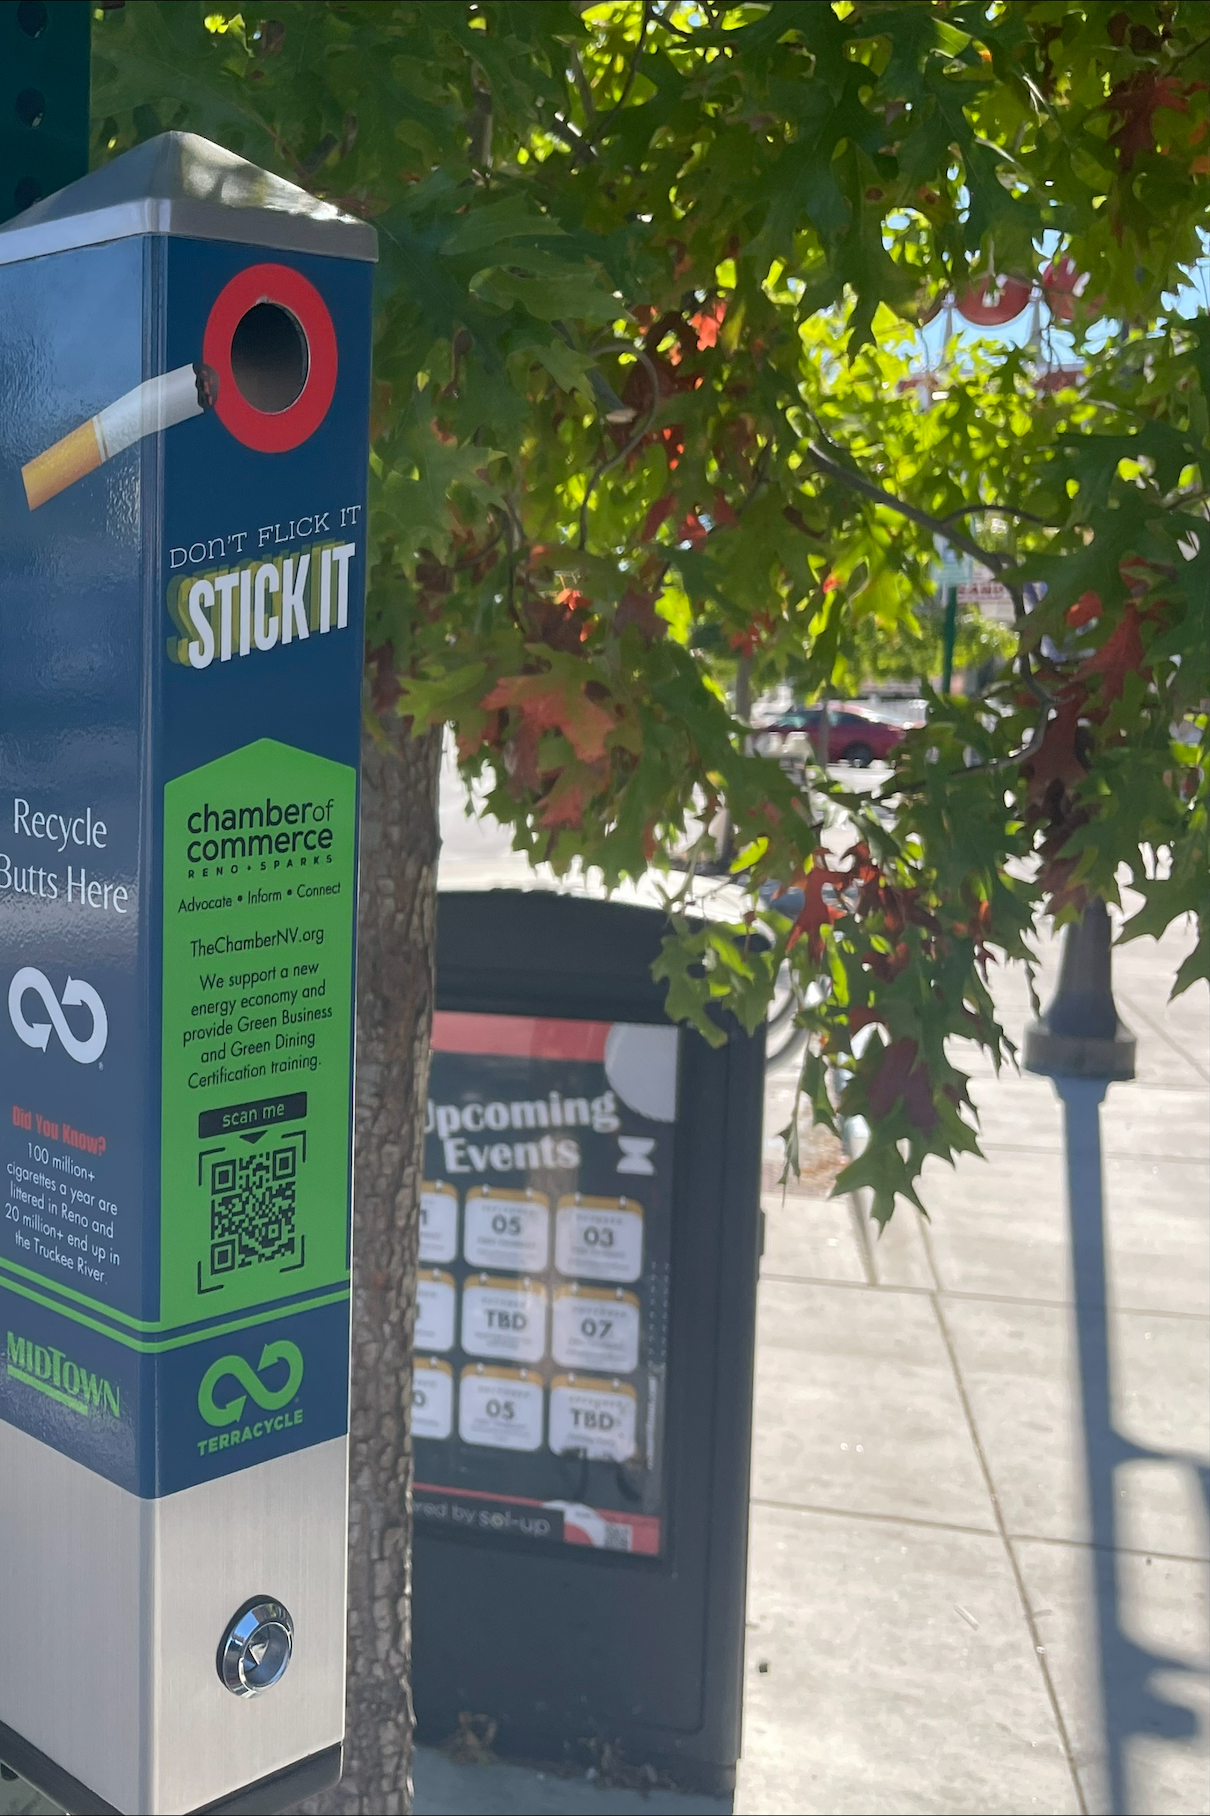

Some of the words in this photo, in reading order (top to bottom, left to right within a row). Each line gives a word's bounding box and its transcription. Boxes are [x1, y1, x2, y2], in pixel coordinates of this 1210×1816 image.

[169, 532, 248, 569] DON'T
[258, 512, 330, 547] FLICK
[340, 505, 362, 528] IT
[187, 553, 310, 670] STICK
[319, 542, 356, 634] IT
[14, 798, 108, 852] Recycle
[187, 828, 333, 863] commerce
[67, 865, 129, 914] Here
[178, 896, 233, 914] Advocate
[247, 888, 282, 905] Inform
[296, 882, 341, 899] Connect
[190, 926, 325, 958] TheChamberNV.org
[199, 973, 224, 992] We
[228, 966, 277, 990] support
[280, 967, 289, 979] a
[293, 963, 320, 977] new
[191, 999, 237, 1017] energy
[240, 989, 298, 1009] economy
[302, 979, 326, 998] and
[183, 1019, 233, 1048] provide
[237, 1015, 277, 1033] Green
[282, 1006, 333, 1026] Business
[200, 1042, 226, 1063] and
[230, 1040, 271, 1058] Green
[275, 1031, 316, 1050] Dining
[187, 1063, 267, 1089] Certification
[271, 1054, 322, 1074] training.
[12, 1104, 32, 1131] Did
[35, 1113, 59, 1141] You
[62, 1123, 106, 1157] Know?
[222, 1108, 258, 1128] scan
[262, 1103, 285, 1120] me
[28, 1142, 49, 1165] 100
[52, 1155, 96, 1182] million+
[442, 1133, 581, 1174] Events
[6, 1161, 57, 1192] cigarettes
[59, 1183, 67, 1196] a
[70, 1187, 95, 1207] year
[98, 1199, 118, 1216] are
[10, 1180, 45, 1210] littered
[48, 1198, 58, 1216] in
[61, 1202, 89, 1228] Reno
[92, 1220, 114, 1239] and
[491, 1214, 522, 1236] 05
[4, 1202, 20, 1222] 20
[22, 1213, 64, 1241] million+
[67, 1234, 88, 1252] end
[91, 1244, 106, 1263] up
[109, 1247, 120, 1266] in
[15, 1229, 31, 1250] the
[33, 1236, 74, 1270] Truckee
[583, 1226, 615, 1248] 03
[485, 1309, 528, 1330] TBD
[580, 1318, 614, 1339] 07
[6, 1330, 120, 1418] MIDTOWN
[485, 1398, 516, 1421] 05
[571, 1407, 615, 1431] TBD
[197, 1408, 304, 1457] TERRACYCLE
[451, 1503, 477, 1525] by
[478, 1510, 551, 1538] sol-up
